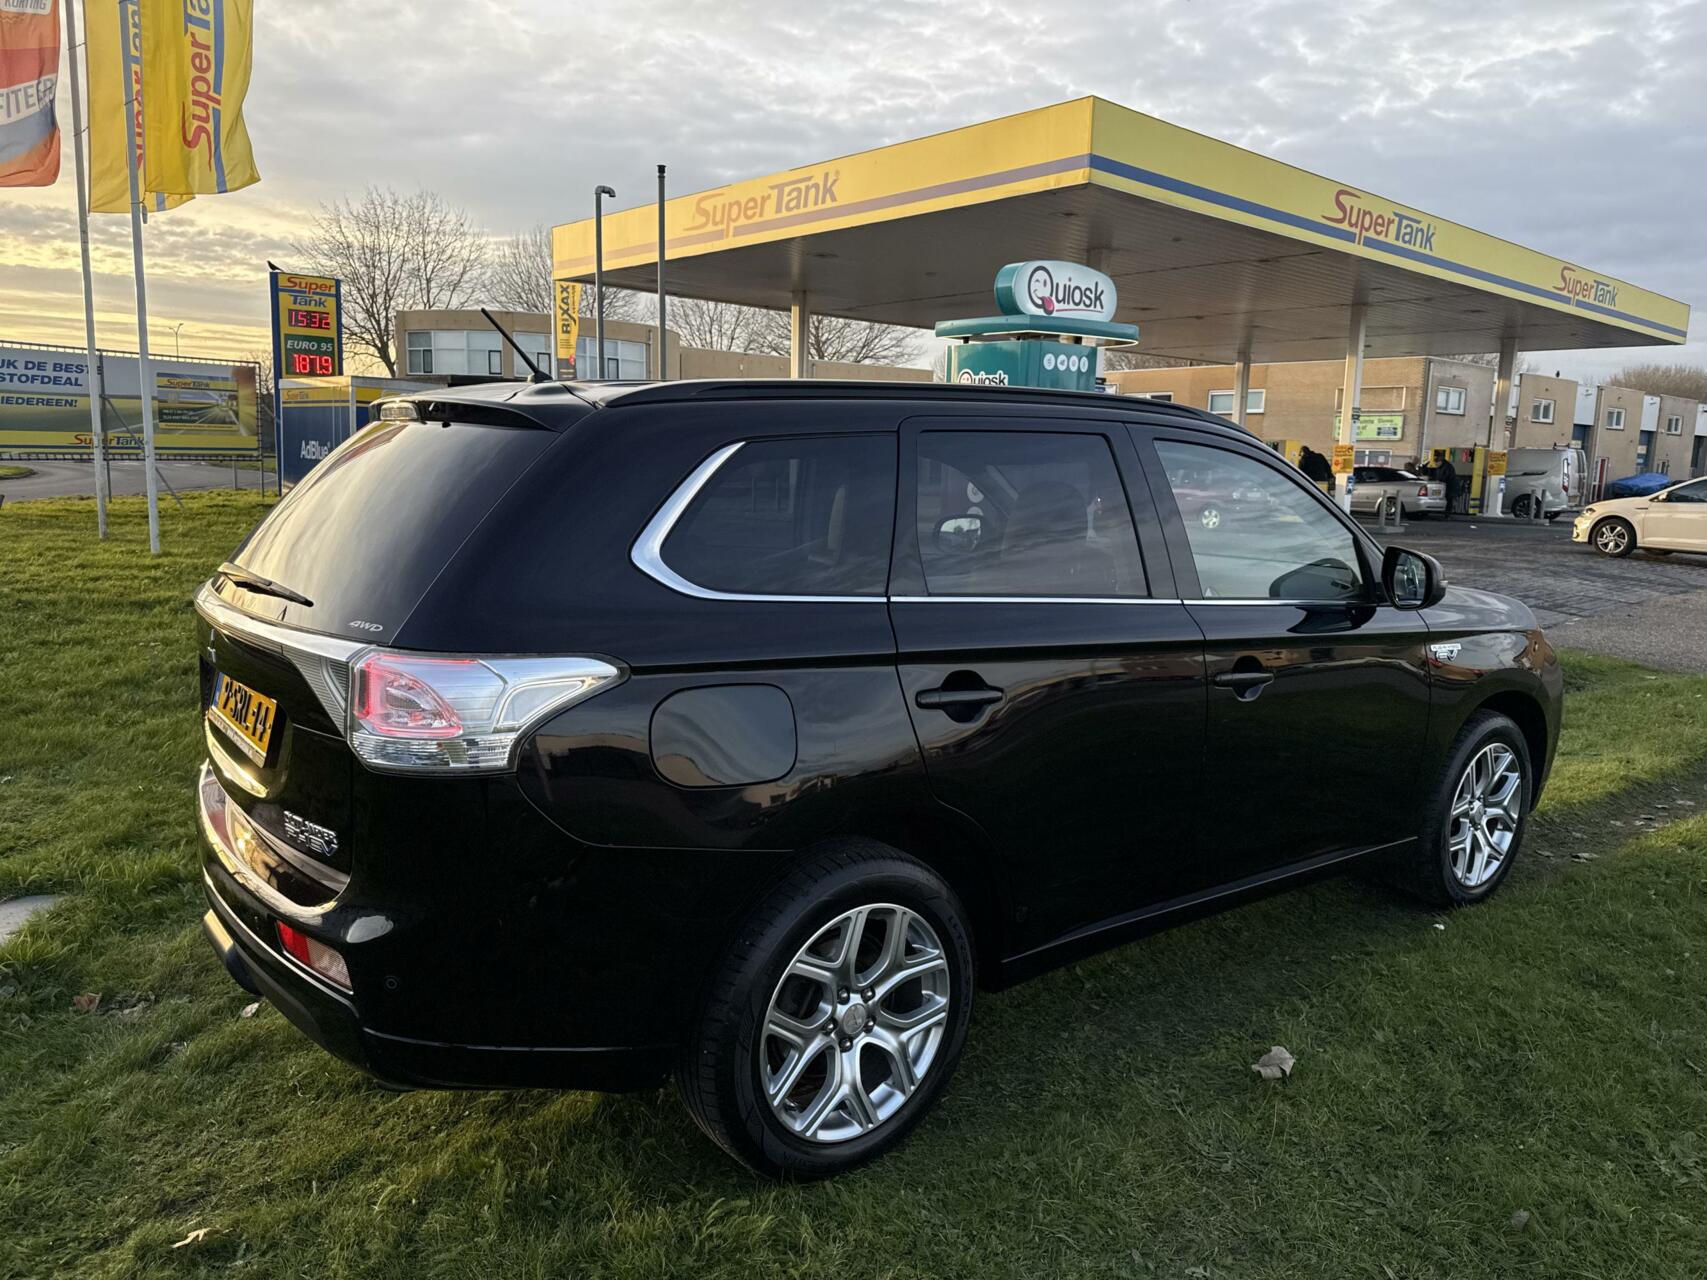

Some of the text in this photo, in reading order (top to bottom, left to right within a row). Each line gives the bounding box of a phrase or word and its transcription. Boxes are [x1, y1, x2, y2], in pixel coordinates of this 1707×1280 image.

[683, 171, 839, 239] SuperTank
[1321, 189, 1436, 252] SuperTank
[280, 276, 335, 295] Super
[1028, 266, 1105, 312] Quiosk
[1552, 266, 1617, 306] SuperTank
[288, 294, 327, 308] Tank
[290, 311, 331, 328] 15:32
[287, 340, 333, 352] EURO 95
[24, 360, 48, 371] DE
